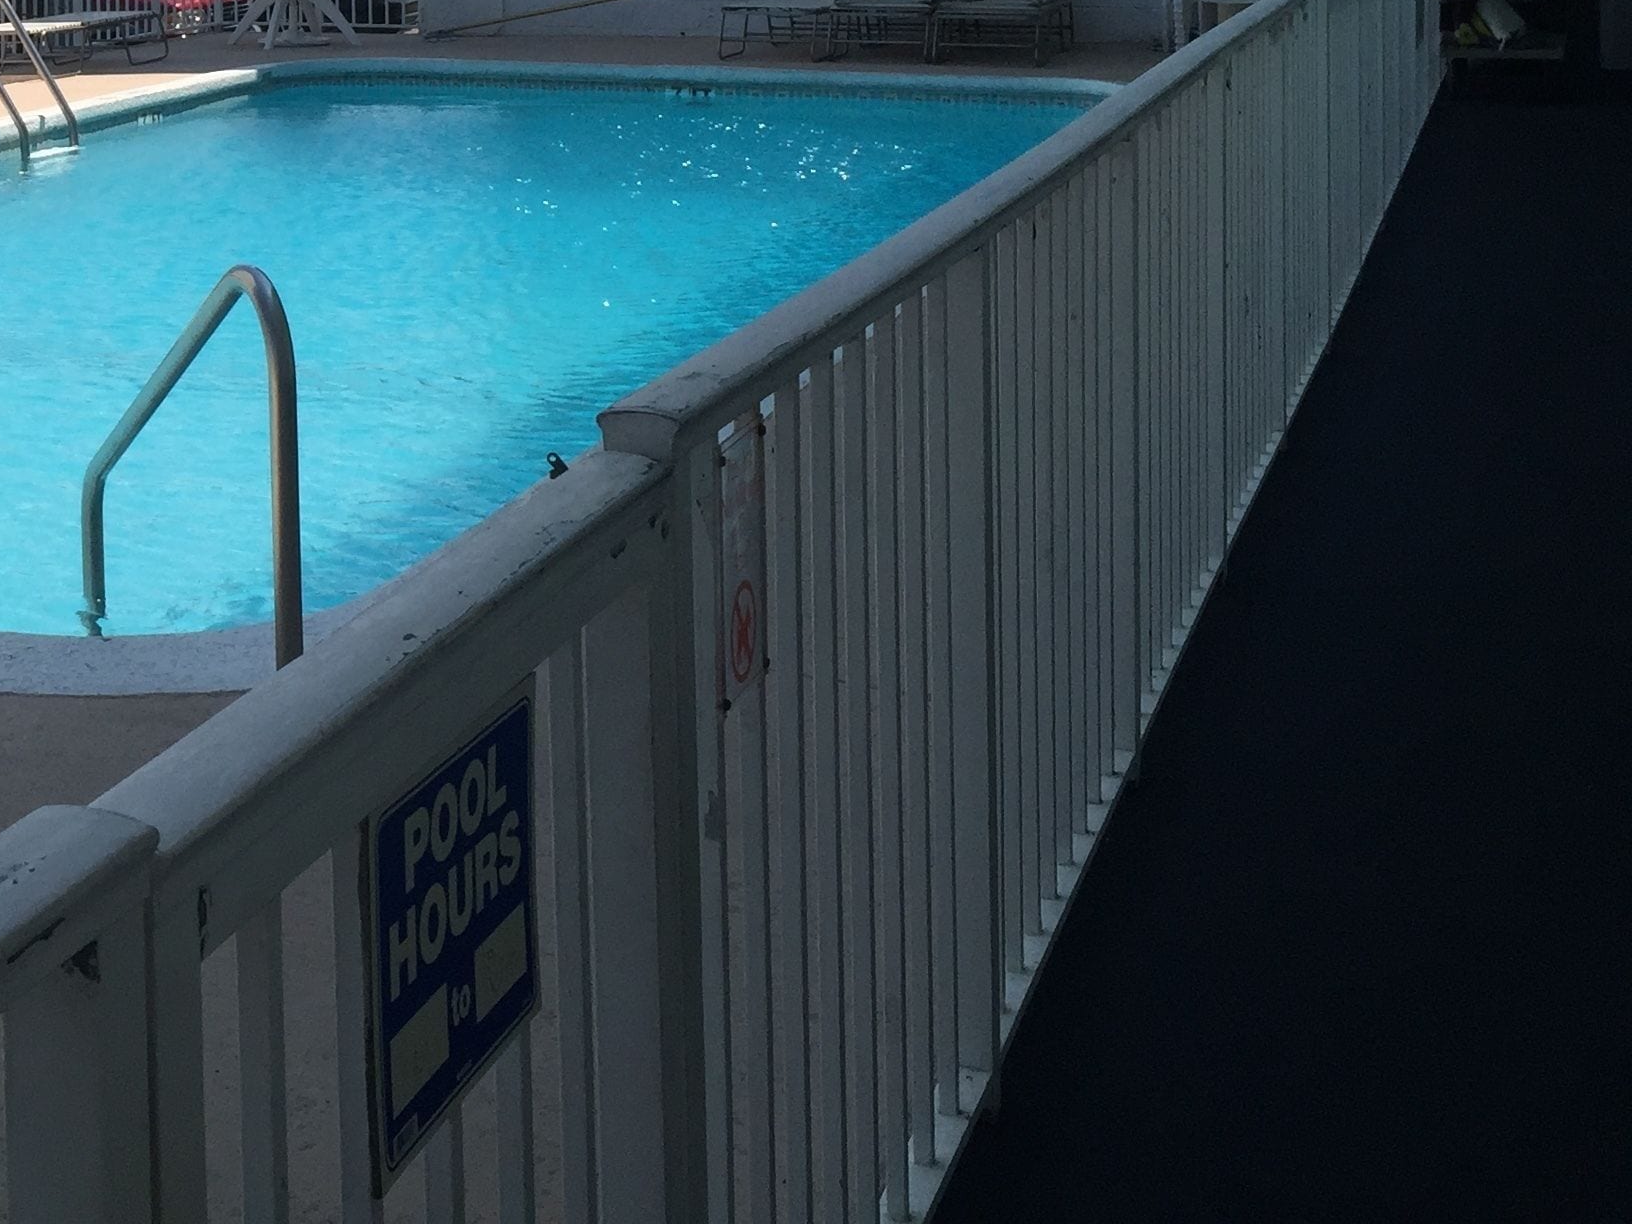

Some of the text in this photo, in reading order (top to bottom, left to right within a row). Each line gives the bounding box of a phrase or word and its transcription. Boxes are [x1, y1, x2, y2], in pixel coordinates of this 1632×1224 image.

[405, 746, 507, 895] POOL
[389, 810, 522, 1004] HOURS
[451, 983, 471, 1027] to
